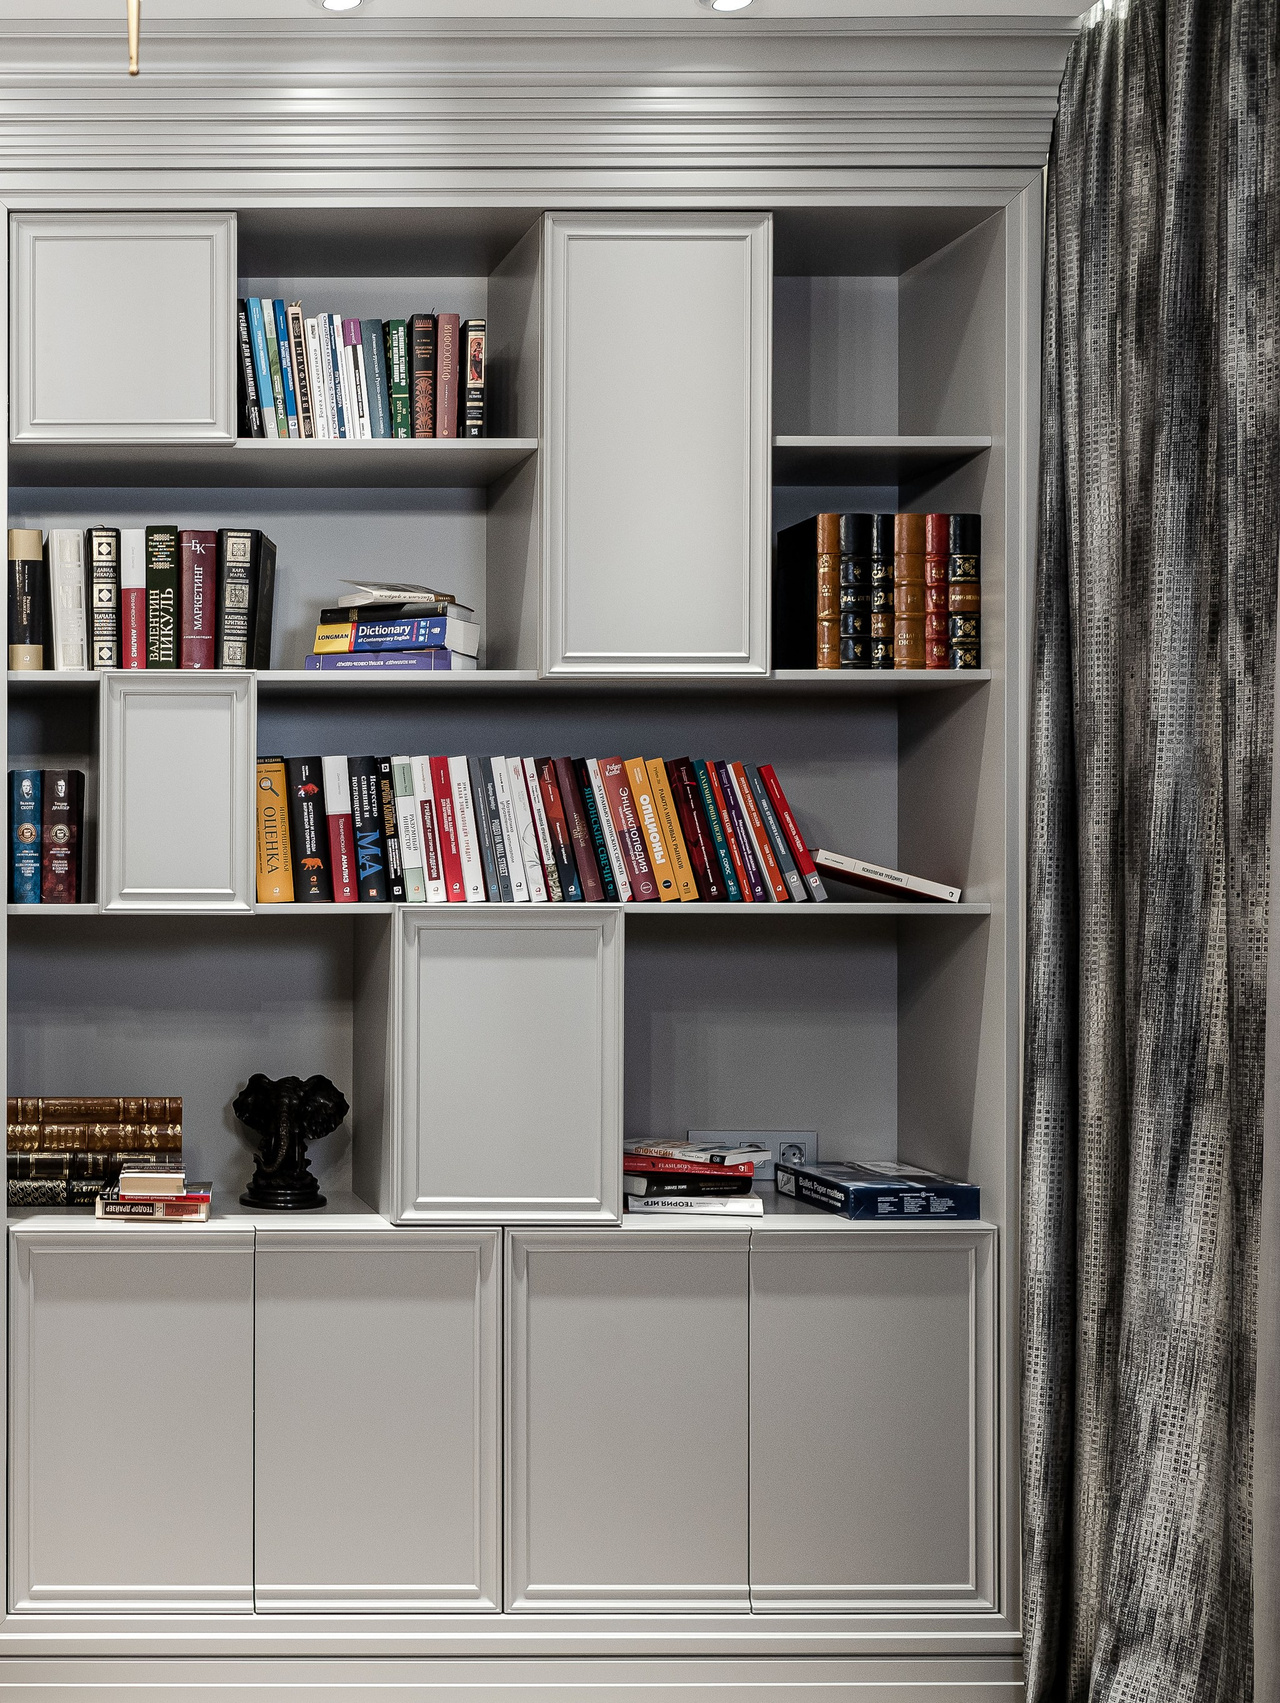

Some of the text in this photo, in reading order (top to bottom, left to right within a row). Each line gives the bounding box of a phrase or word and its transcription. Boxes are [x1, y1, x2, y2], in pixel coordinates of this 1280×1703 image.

[239, 312, 256, 400] ТРЕЙДИНГ ДЛЯ НАЧИНАЮЩИХ
[296, 346, 309, 408] ВЕЛЬФЛИН
[441, 324, 452, 380] ФИЛОСОФИЯ
[276, 395, 284, 420] FOREX
[191, 539, 206, 555] БК
[194, 565, 203, 630] МАРКЕТИНГ
[150, 589, 160, 662] ВАЛЕНТИН
[160, 587, 174, 662] ПИКУЛЬ
[359, 625, 411, 636] Dictionary
[352, 776, 362, 827] поглощений
[361, 776, 370, 812] слияний
[370, 775, 378, 817] Искусство
[380, 780, 394, 836] КОРОЛЬ КАПИТАЛА
[506, 800, 514, 833] Математика
[699, 769, 722, 843] АЛХИМИЯ ФИНАНСОВ
[263, 806, 279, 874] ОЦЕНКА
[280, 806, 289, 872] ИНВЕСТИЦИОННАЯ
[356, 829, 383, 880] M&A
[403, 815, 411, 851] ИНВЕСТОР
[409, 814, 418, 851] РАЗУМНЫЙ
[458, 801, 468, 838] ЭНЦИКЛОПЕДИЯ
[464, 840, 472, 863] ТРЕЙДЕРА
[495, 836, 501, 844] НА
[495, 844, 504, 858] WALL
[584, 787, 612, 882] ЯПОНСКИЕ СВЕЧИ
[597, 784, 624, 876] ЗА ГРАНЬЮ ЯПОНСКИХ СВЕЧЕЙ
[619, 787, 648, 873] Энциклопедия
[640, 794, 666, 864] ОПЦИОНЫ
[658, 788, 684, 870] РАБОТА МИРОВЫХ РЫНКОВ
[341, 855, 349, 883] АНАЛИЗ
[498, 858, 508, 877] STREET
[634, 1146, 673, 1157] БЛОКЧЕЙН
[134, 1205, 153, 1213] ТЕОДОР
[814, 1182, 827, 1193] Paper
[827, 1189, 844, 1200] matters
